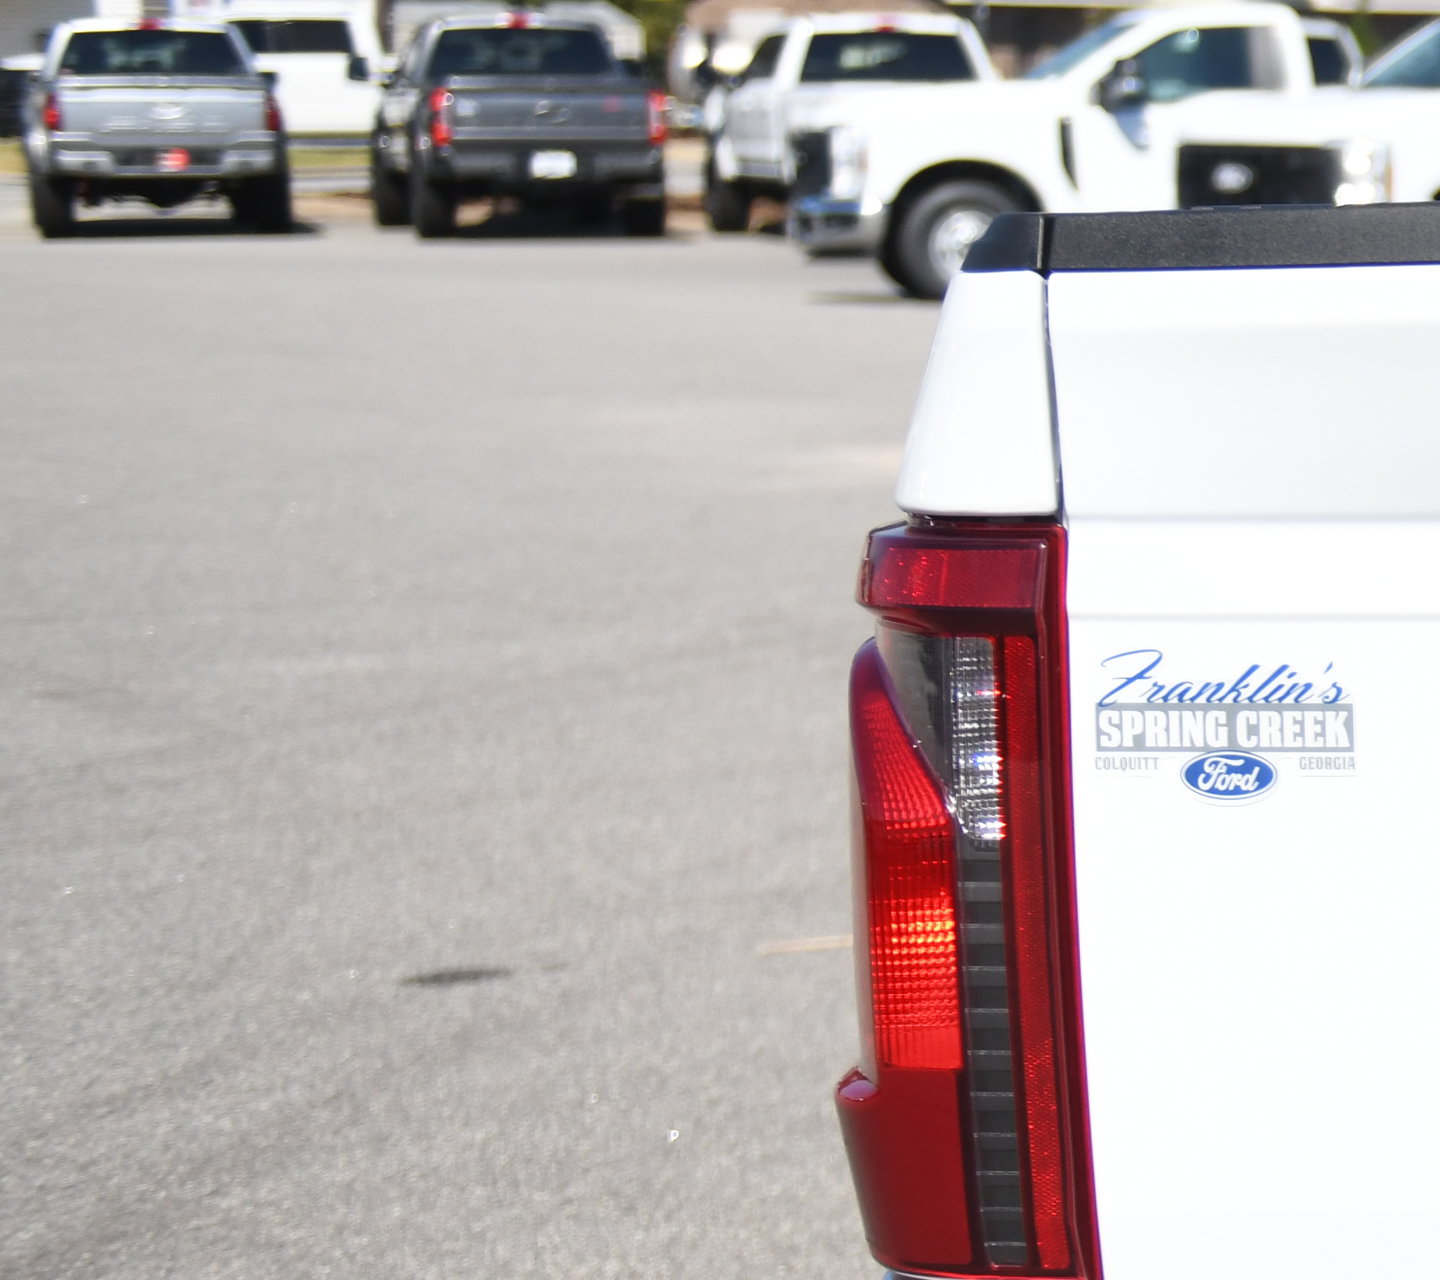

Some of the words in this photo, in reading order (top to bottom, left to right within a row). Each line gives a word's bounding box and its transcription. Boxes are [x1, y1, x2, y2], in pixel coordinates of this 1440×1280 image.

[1097, 649, 1351, 708] Franklin's
[1098, 710, 1229, 749] SPRING
[1236, 710, 1350, 748] CREEK
[1095, 756, 1159, 771] COLQUITT
[1197, 755, 1261, 792] Ford
[1299, 756, 1356, 770] GEORGIA
